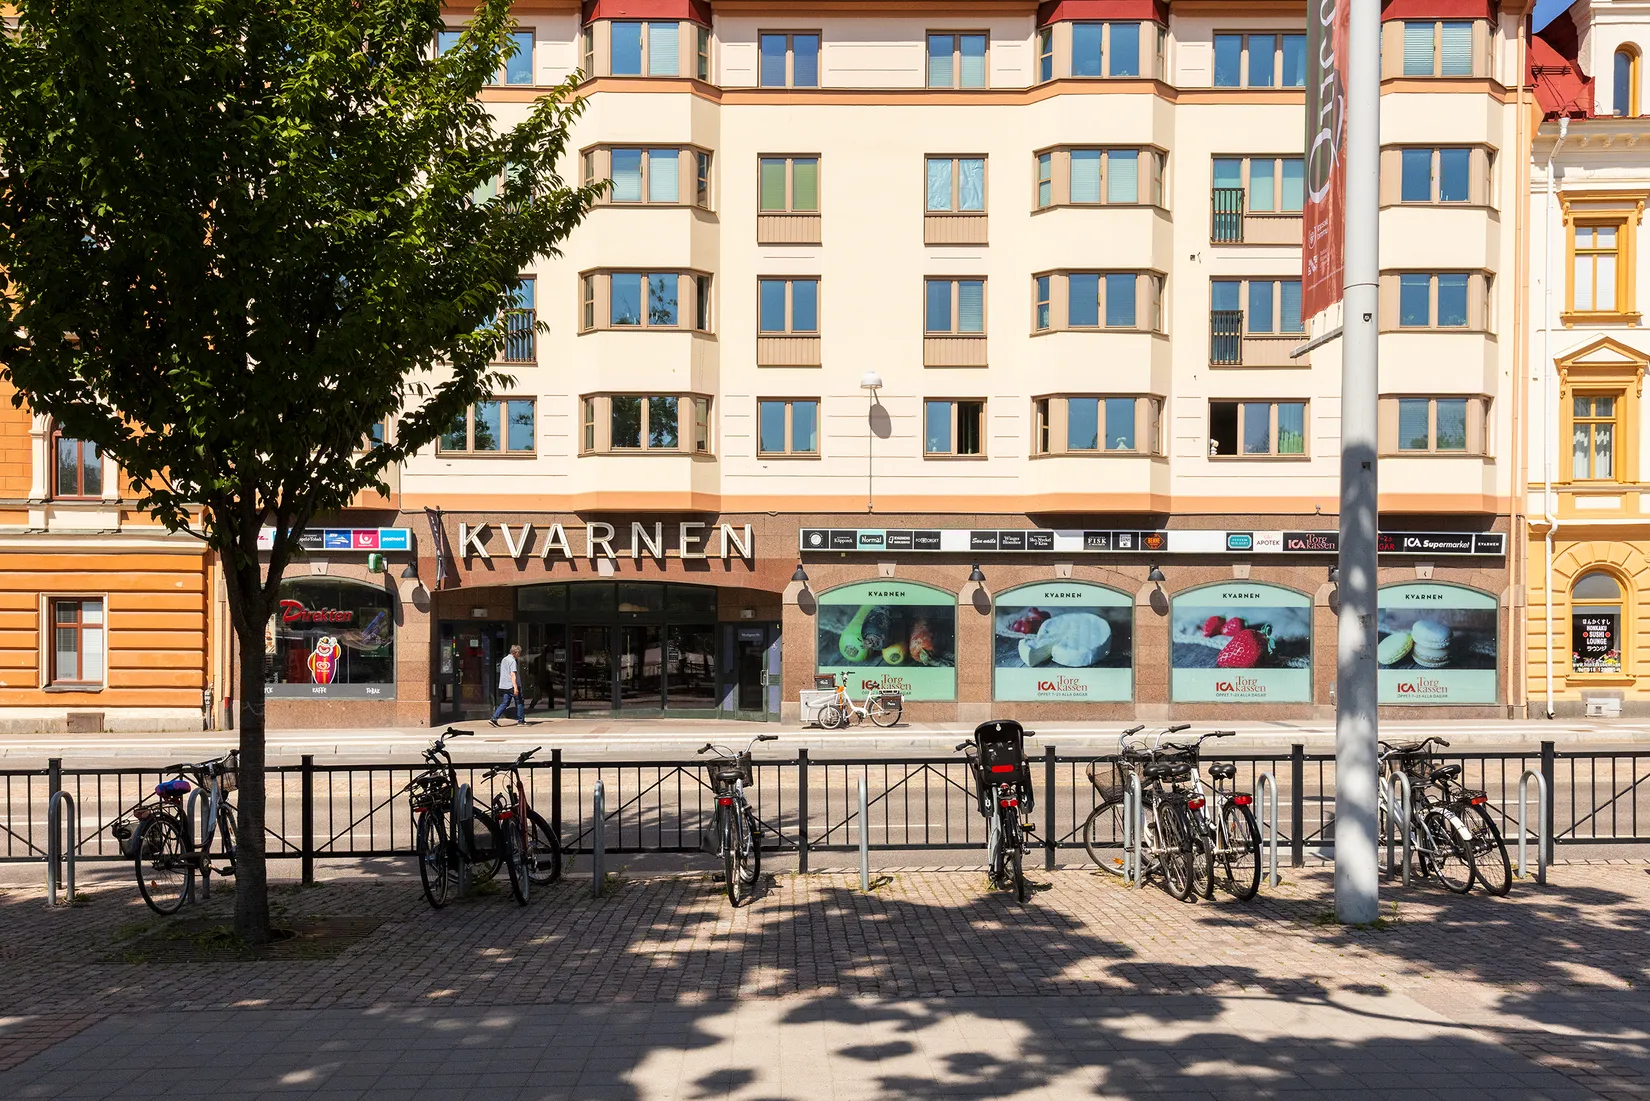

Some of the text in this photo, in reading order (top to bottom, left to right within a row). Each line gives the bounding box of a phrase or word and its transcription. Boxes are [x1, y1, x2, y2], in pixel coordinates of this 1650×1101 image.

[459, 521, 752, 559] KVARNEN
[1306, 533, 1328, 544] Torg
[1404, 537, 1470, 549] ICA Supermarket
[1288, 539, 1306, 549] ICA
[1306, 540, 1335, 549] kassen
[279, 599, 354, 623] Direkten
[881, 674, 903, 684] Torg
[1057, 675, 1080, 686] Torg
[1235, 676, 1258, 686] Torg
[1417, 677, 1440, 687] Torg
[862, 680, 881, 690] ICA
[880, 680, 912, 690] kassen
[1038, 681, 1056, 691] ICA
[1057, 681, 1088, 691] kassen
[1216, 682, 1235, 692] ICA
[1235, 682, 1266, 692] kassen
[1397, 683, 1416, 693] ICA
[1417, 683, 1448, 693] kassen
